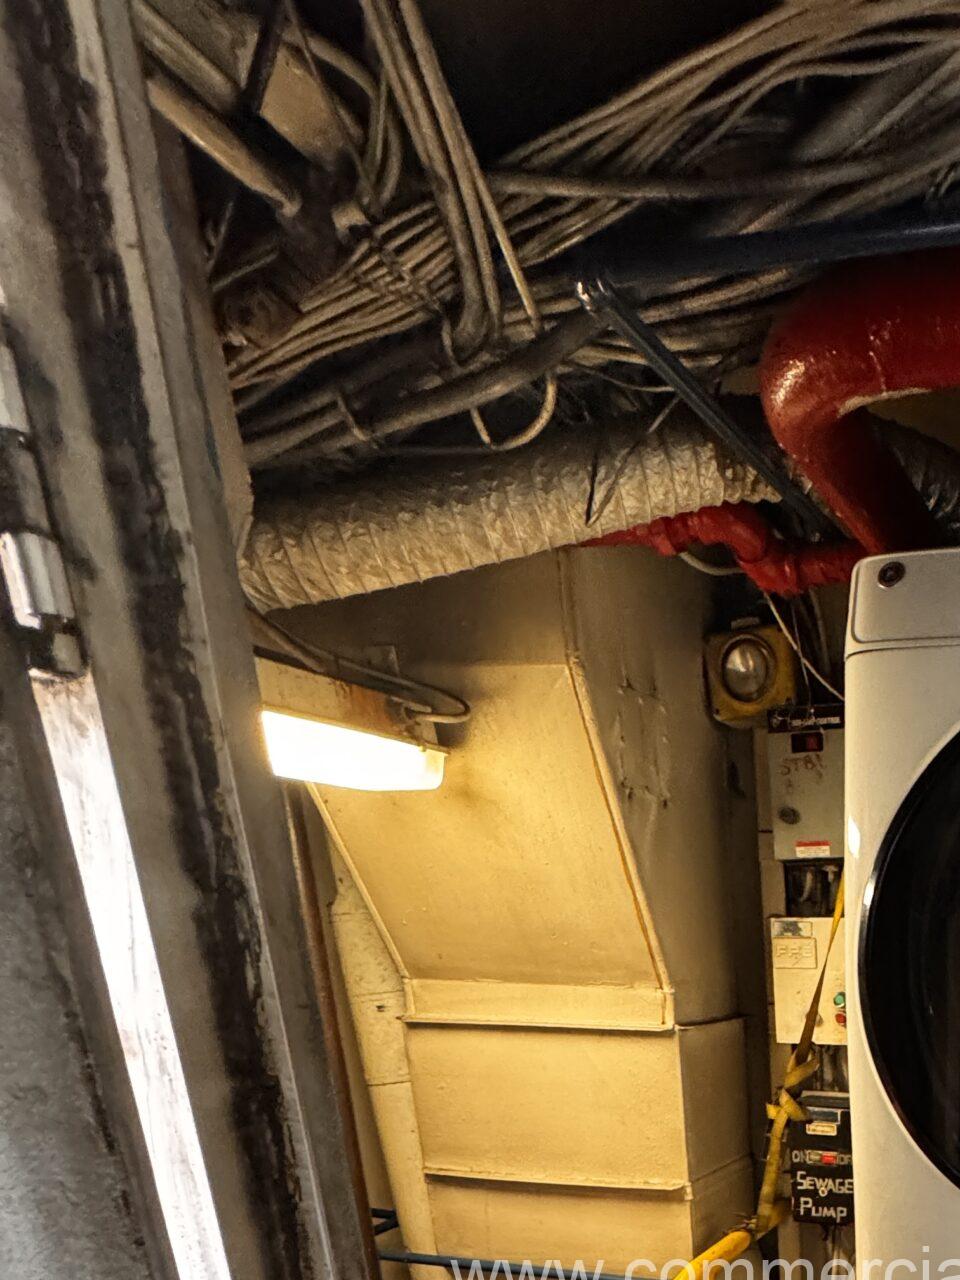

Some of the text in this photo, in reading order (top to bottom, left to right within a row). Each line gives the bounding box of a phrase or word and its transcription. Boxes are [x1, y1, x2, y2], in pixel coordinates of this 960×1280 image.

[791, 1149, 808, 1164] ON
[796, 1170, 854, 1194] SEWAGE
[799, 1196, 848, 1224] PUMP
